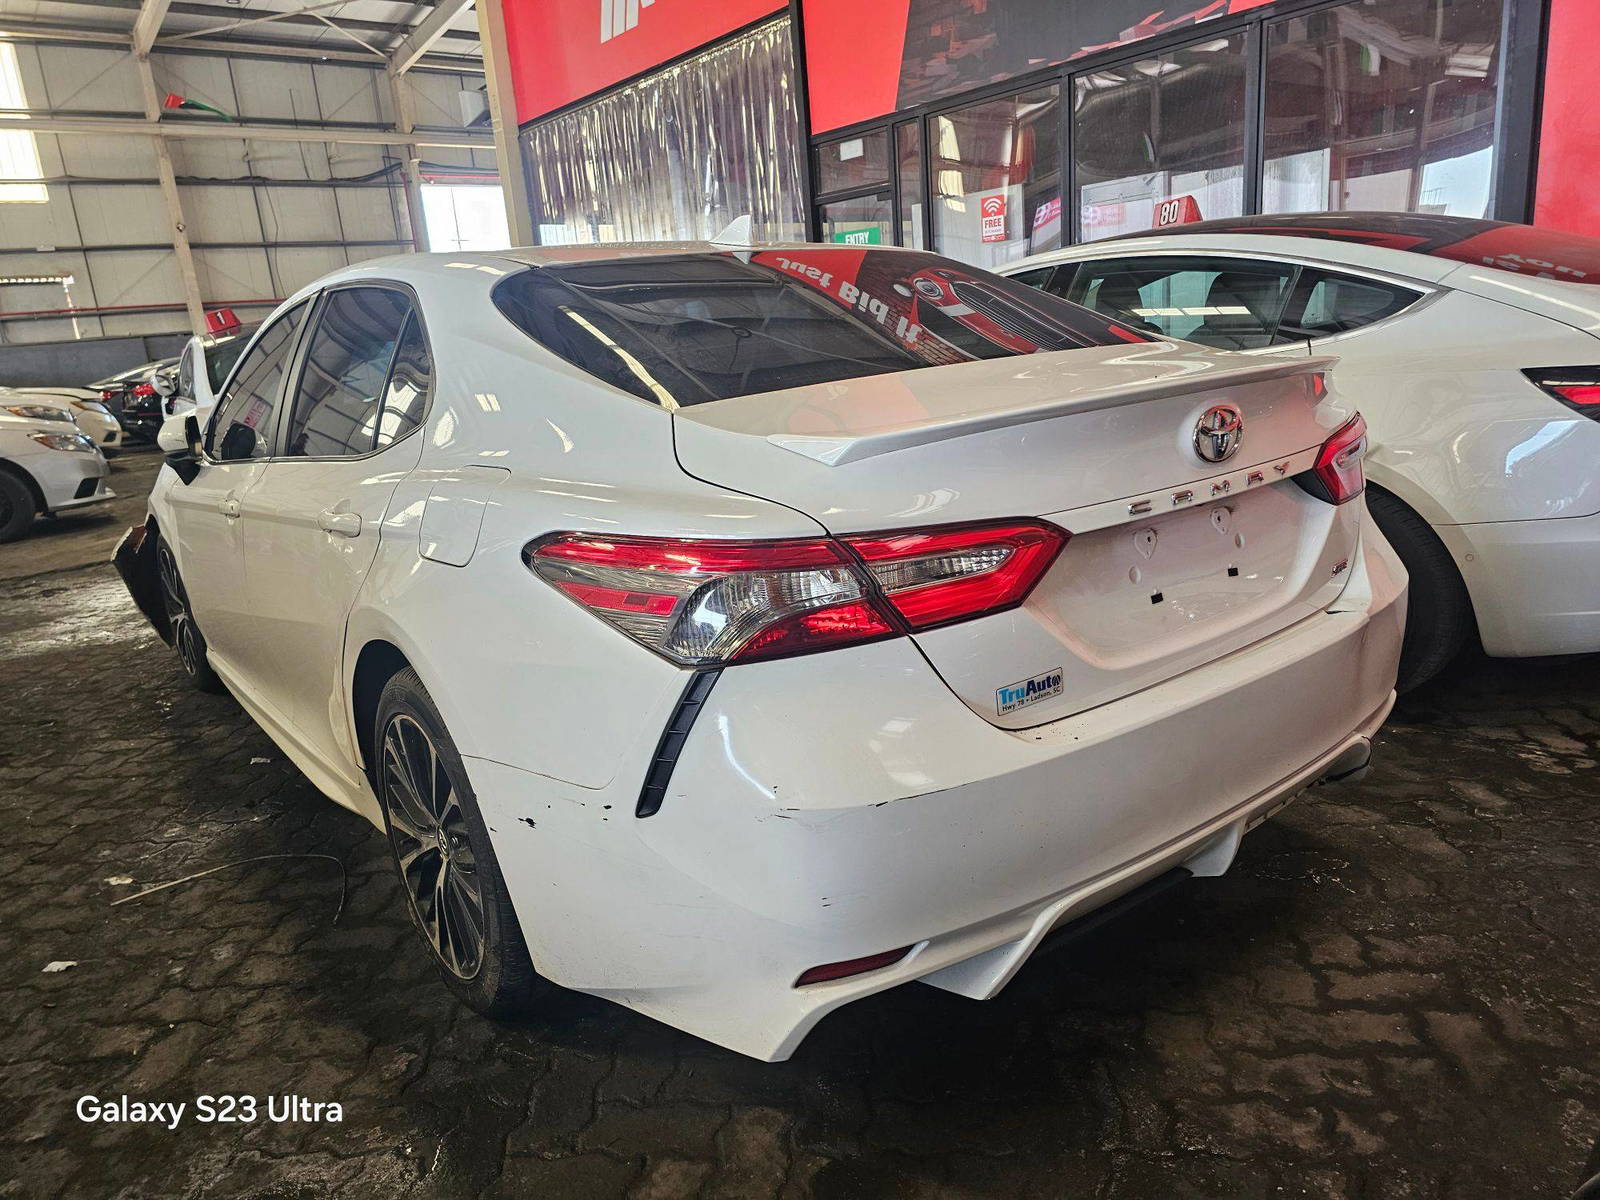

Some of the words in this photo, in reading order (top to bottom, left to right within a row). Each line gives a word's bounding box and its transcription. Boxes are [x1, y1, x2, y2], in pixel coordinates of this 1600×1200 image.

[984, 217, 1002, 229] FREE
[1159, 199, 1179, 226] 80
[844, 231, 870, 245] ENTRY
[216, 311, 226, 325] 1
[1127, 461, 1290, 517] CAMRY
[998, 674, 1062, 705] TruAuto
[1002, 703, 1016, 712] Hwy
[1053, 686, 1061, 694] SC
